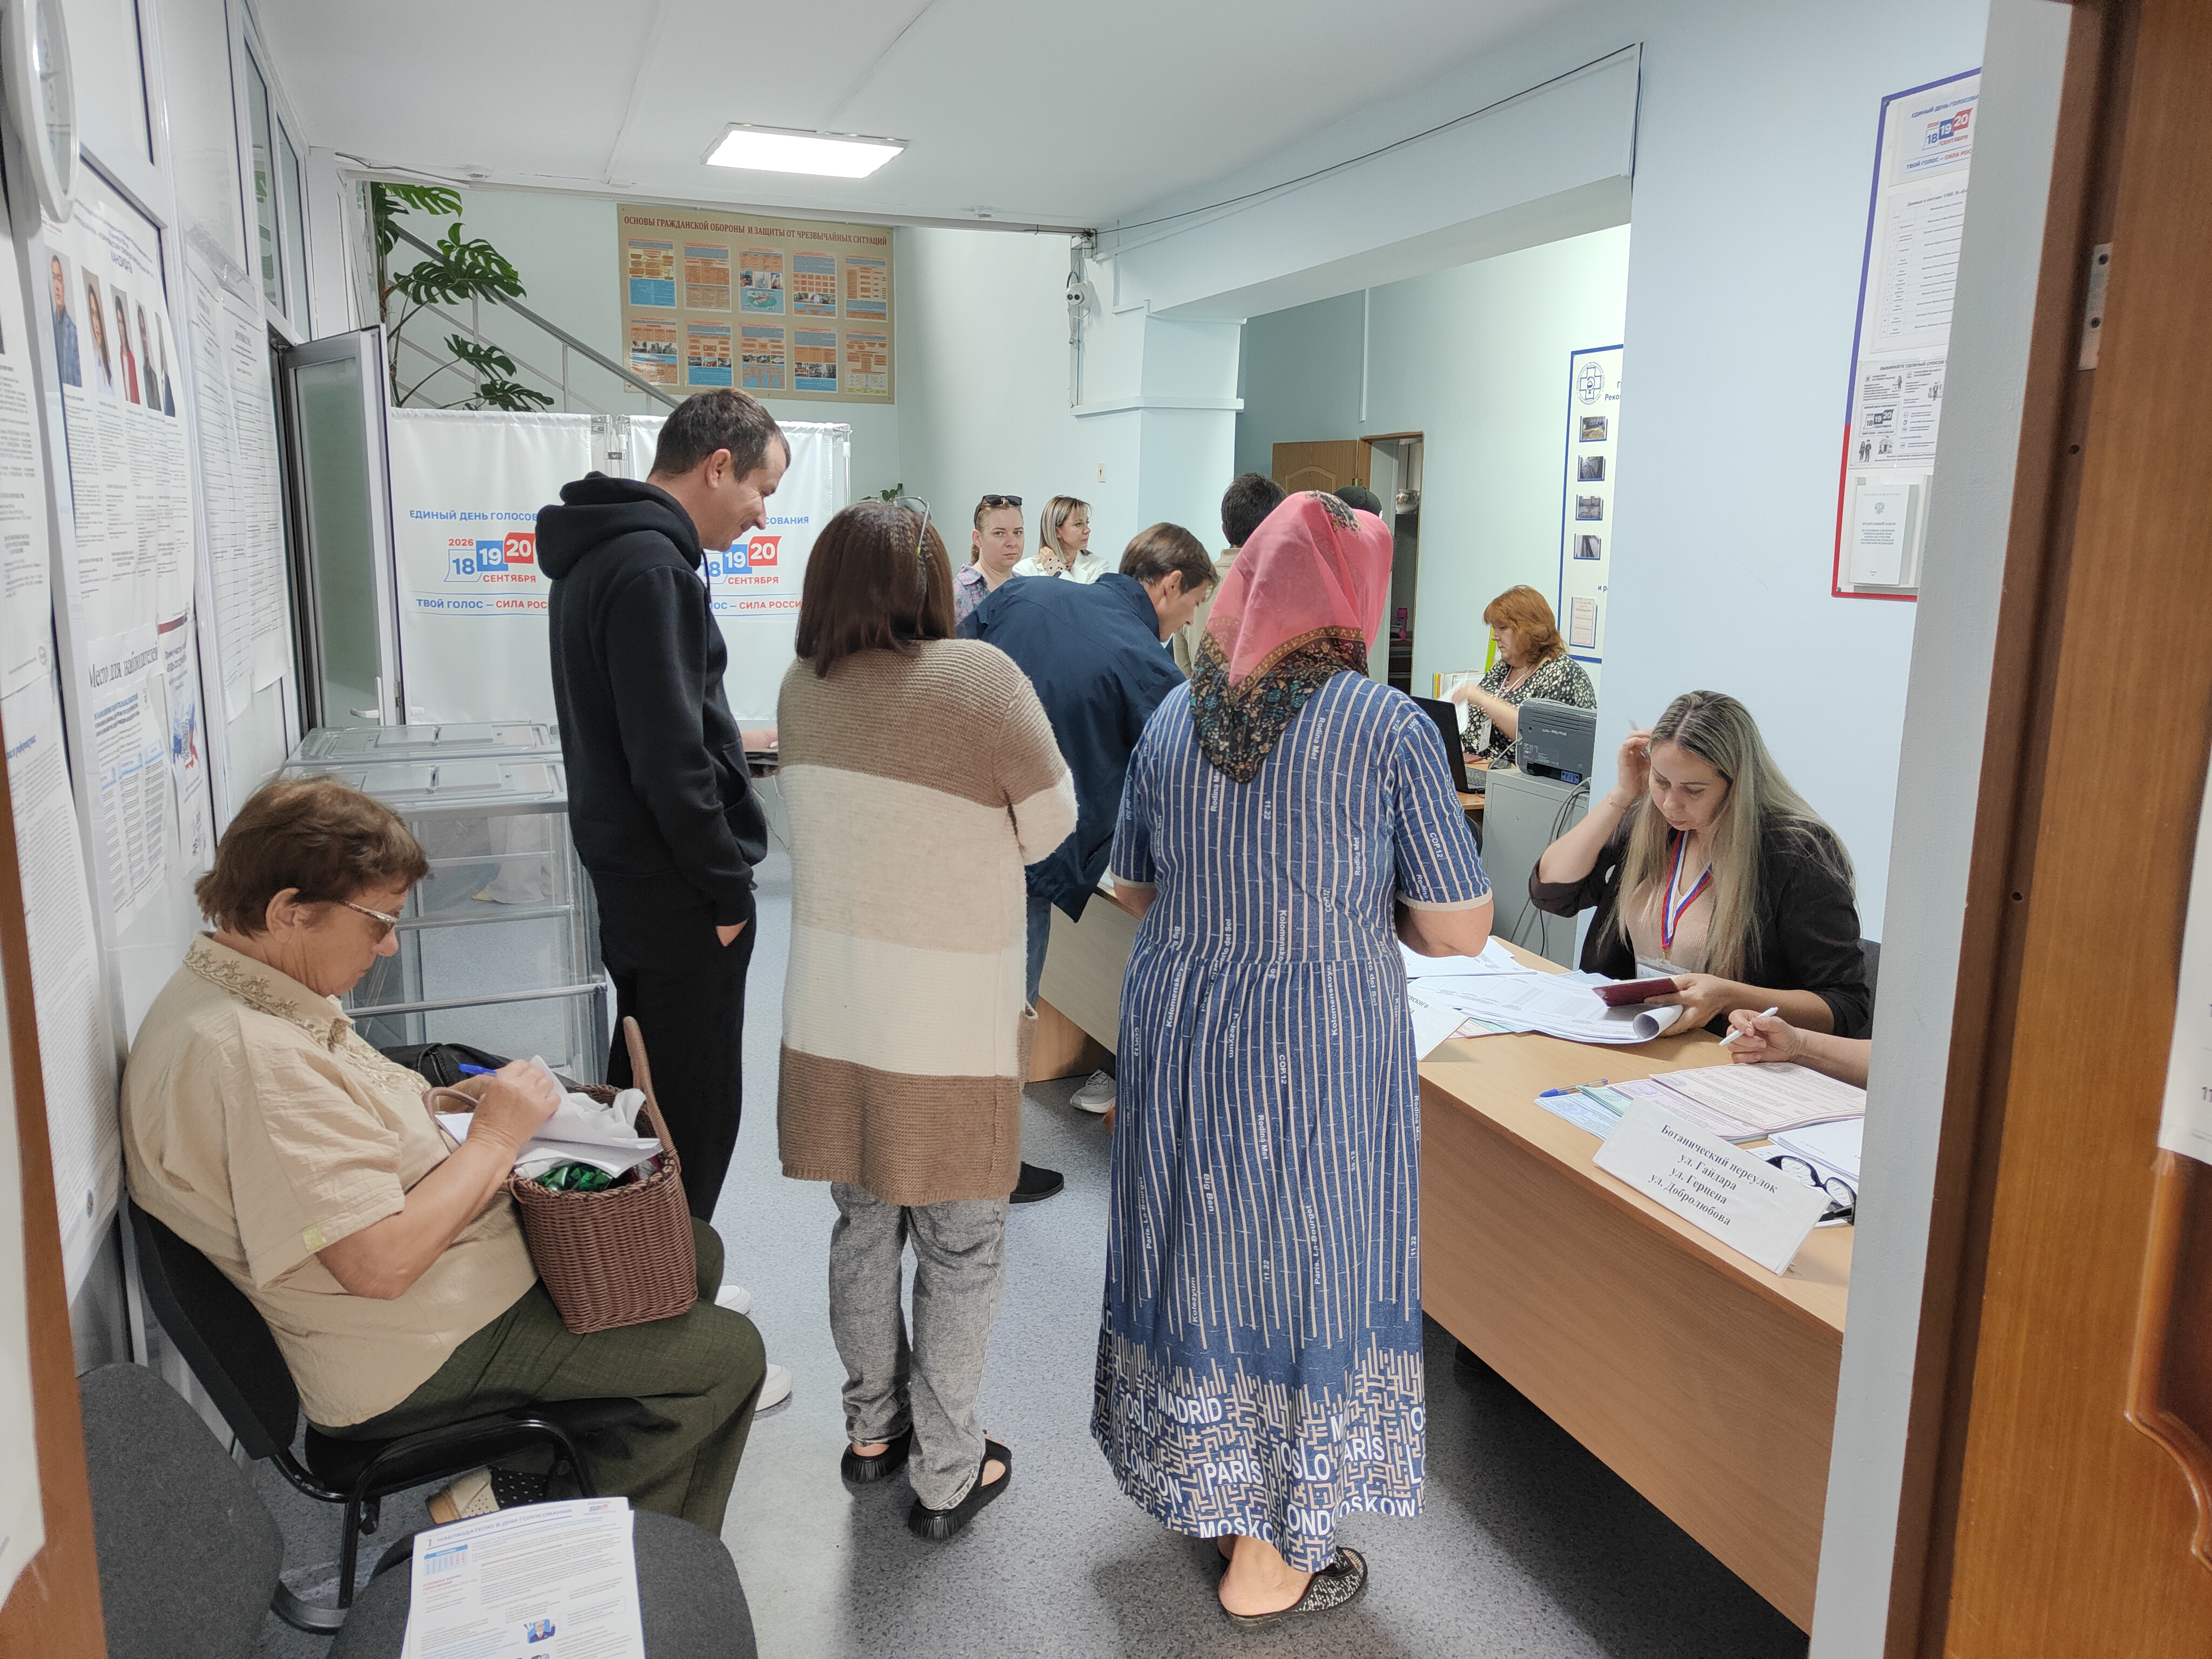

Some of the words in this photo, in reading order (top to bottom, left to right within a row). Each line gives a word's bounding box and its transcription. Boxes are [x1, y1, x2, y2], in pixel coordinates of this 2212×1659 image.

[1927, 132, 1938, 145] 18
[1940, 123, 1952, 135] 19
[1954, 114, 1968, 127] 20
[624, 216, 655, 226] ОСНОВЫ
[657, 219, 709, 231] ГРАЖДАНСКОЙ
[710, 223, 745, 233] ОБОРОНЫ
[754, 227, 785, 237] ЗАЩИТЫ
[787, 230, 795, 238] ОТ
[797, 231, 852, 242] ЧРЕЗВЫЧАЙНЫХ
[853, 235, 887, 246] СИТУАЦИЙ
[409, 510, 456, 520] ЕДИНЫЙ
[459, 512, 488, 521] ДЕНЬ
[490, 512, 538, 521] ГОЛОСОВ
[766, 516, 809, 524] СОВАНИЯ
[453, 558, 475, 575] 18
[479, 548, 502, 565] 19
[506, 539, 531, 557] 20
[725, 551, 746, 568] 19
[750, 543, 775, 559] 20
[483, 575, 536, 583] СЕНТЯБРЯ
[416, 599, 444, 608] ТВОЙ
[769, 601, 802, 609] РОССИ
[89, 664, 107, 687] Место
[110, 662, 122, 682] для
[123, 641, 158, 677] наблюдателей
[1210, 786, 1219, 812] Rodina
[1275, 909, 1287, 966] Kolomenskoy
[1661, 1124, 1730, 1167] Ботанический
[1729, 1163, 1778, 1194] переулок
[1677, 1155, 1692, 1166] ул.
[1695, 1162, 1737, 1191] Гайдара
[1648, 1174, 1663, 1186] ул.
[1663, 1182, 1731, 1225] Добролюбова
[1668, 1168, 1683, 1180] ул.
[1686, 1175, 1727, 1204] Герцена
[1125, 1389, 1156, 1438] OSLO
[1157, 1382, 1222, 1425] MADRID
[1280, 1437, 1330, 1480] OSLO
[1343, 1427, 1385, 1465] ARIS
[1122, 1425, 1182, 1513] LONDON
[1203, 1449, 1264, 1496] PARIS
[1339, 1483, 1415, 1518] OSKOW
[437, 1525, 494, 1542] НАБЛЮДАТЕЛЮ
[502, 1518, 517, 1527] ДНИ
[519, 1508, 572, 1522] ГОЛОСОВАНИЯ
[1199, 1505, 1274, 1545] MOSKO
